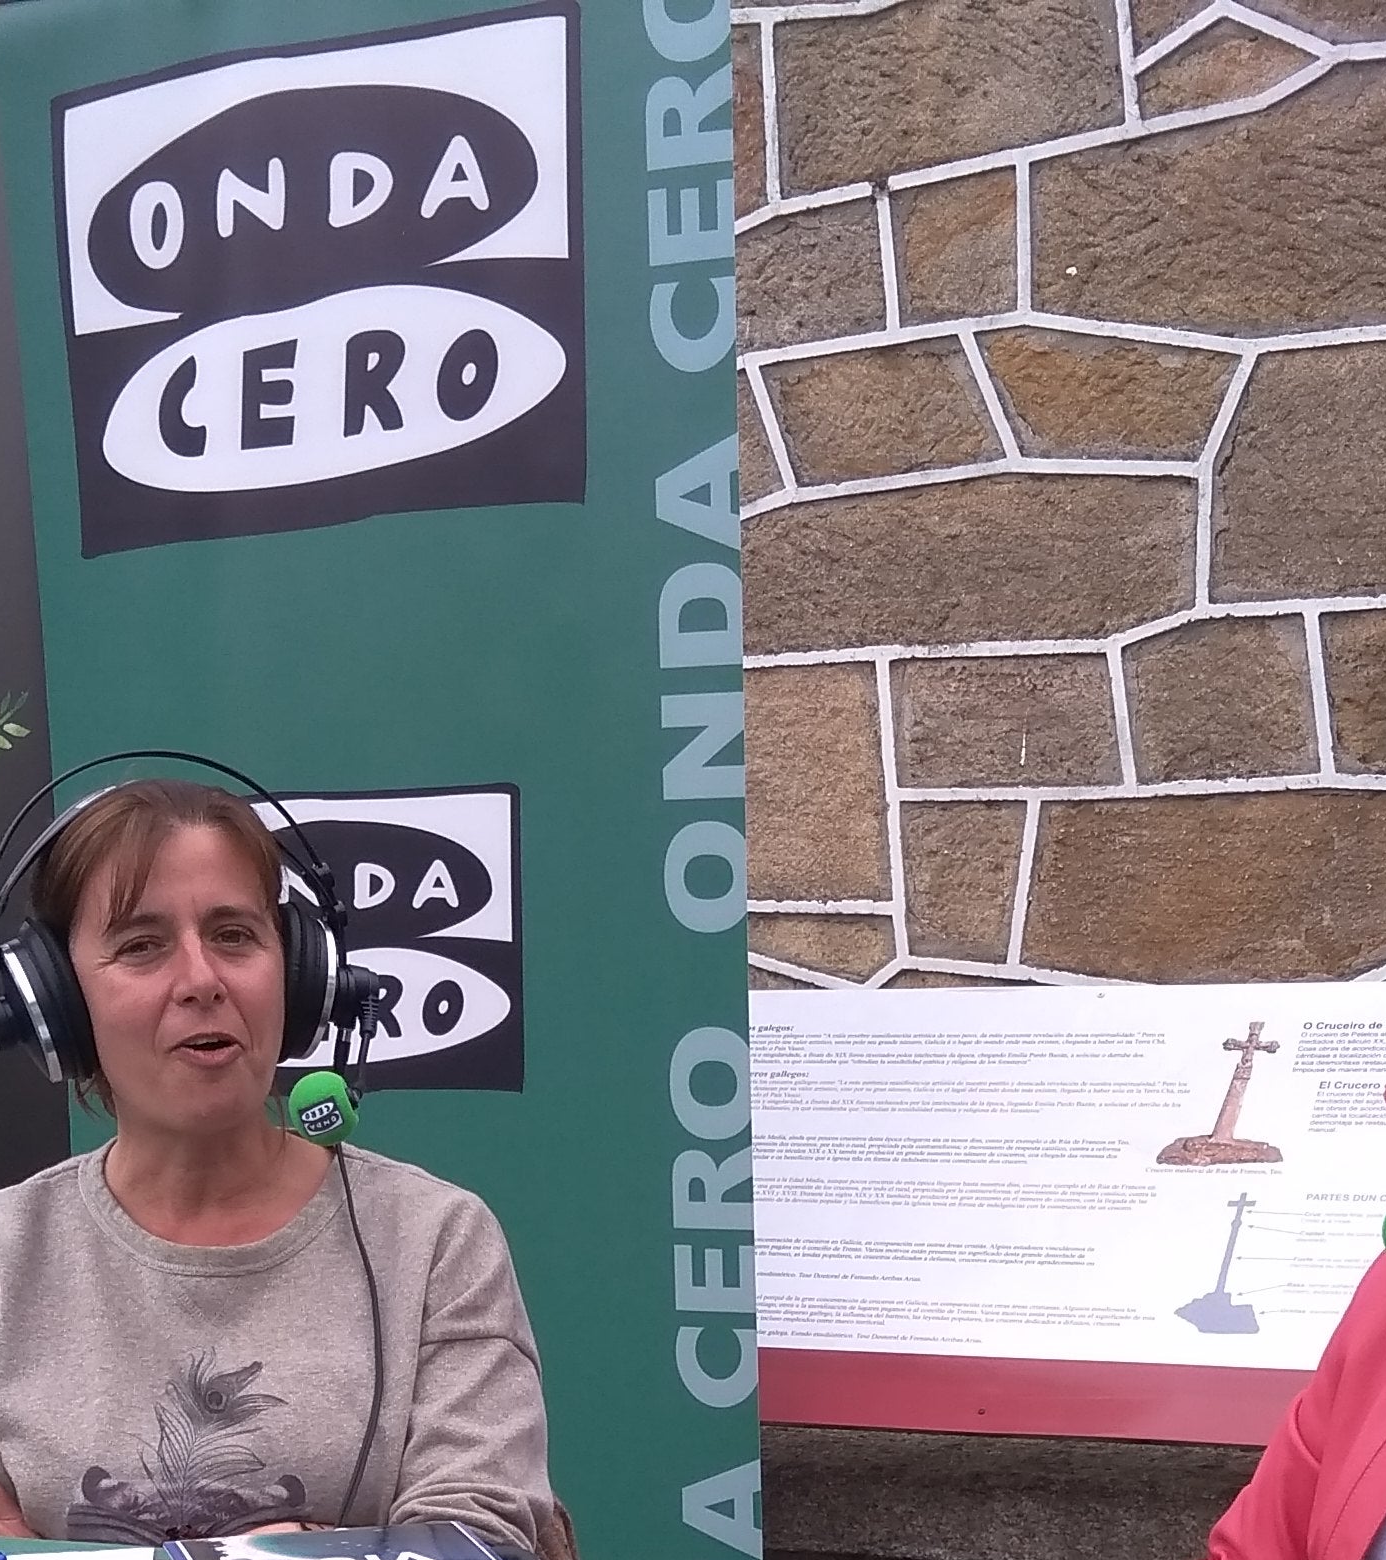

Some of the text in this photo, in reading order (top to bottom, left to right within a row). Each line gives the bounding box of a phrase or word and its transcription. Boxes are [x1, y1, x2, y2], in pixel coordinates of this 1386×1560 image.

[130, 134, 489, 270] ONDA
[159, 328, 499, 458] CERO
[655, 432, 748, 933] ONDA
[278, 860, 459, 909] NDA
[770, 1070, 809, 1078] gallegos:
[1319, 1081, 1380, 1089] El Crucero
[669, 1025, 759, 1408] CERO
[1306, 1193, 1350, 1201] PARTES
[1353, 1194, 1377, 1202] DUN
